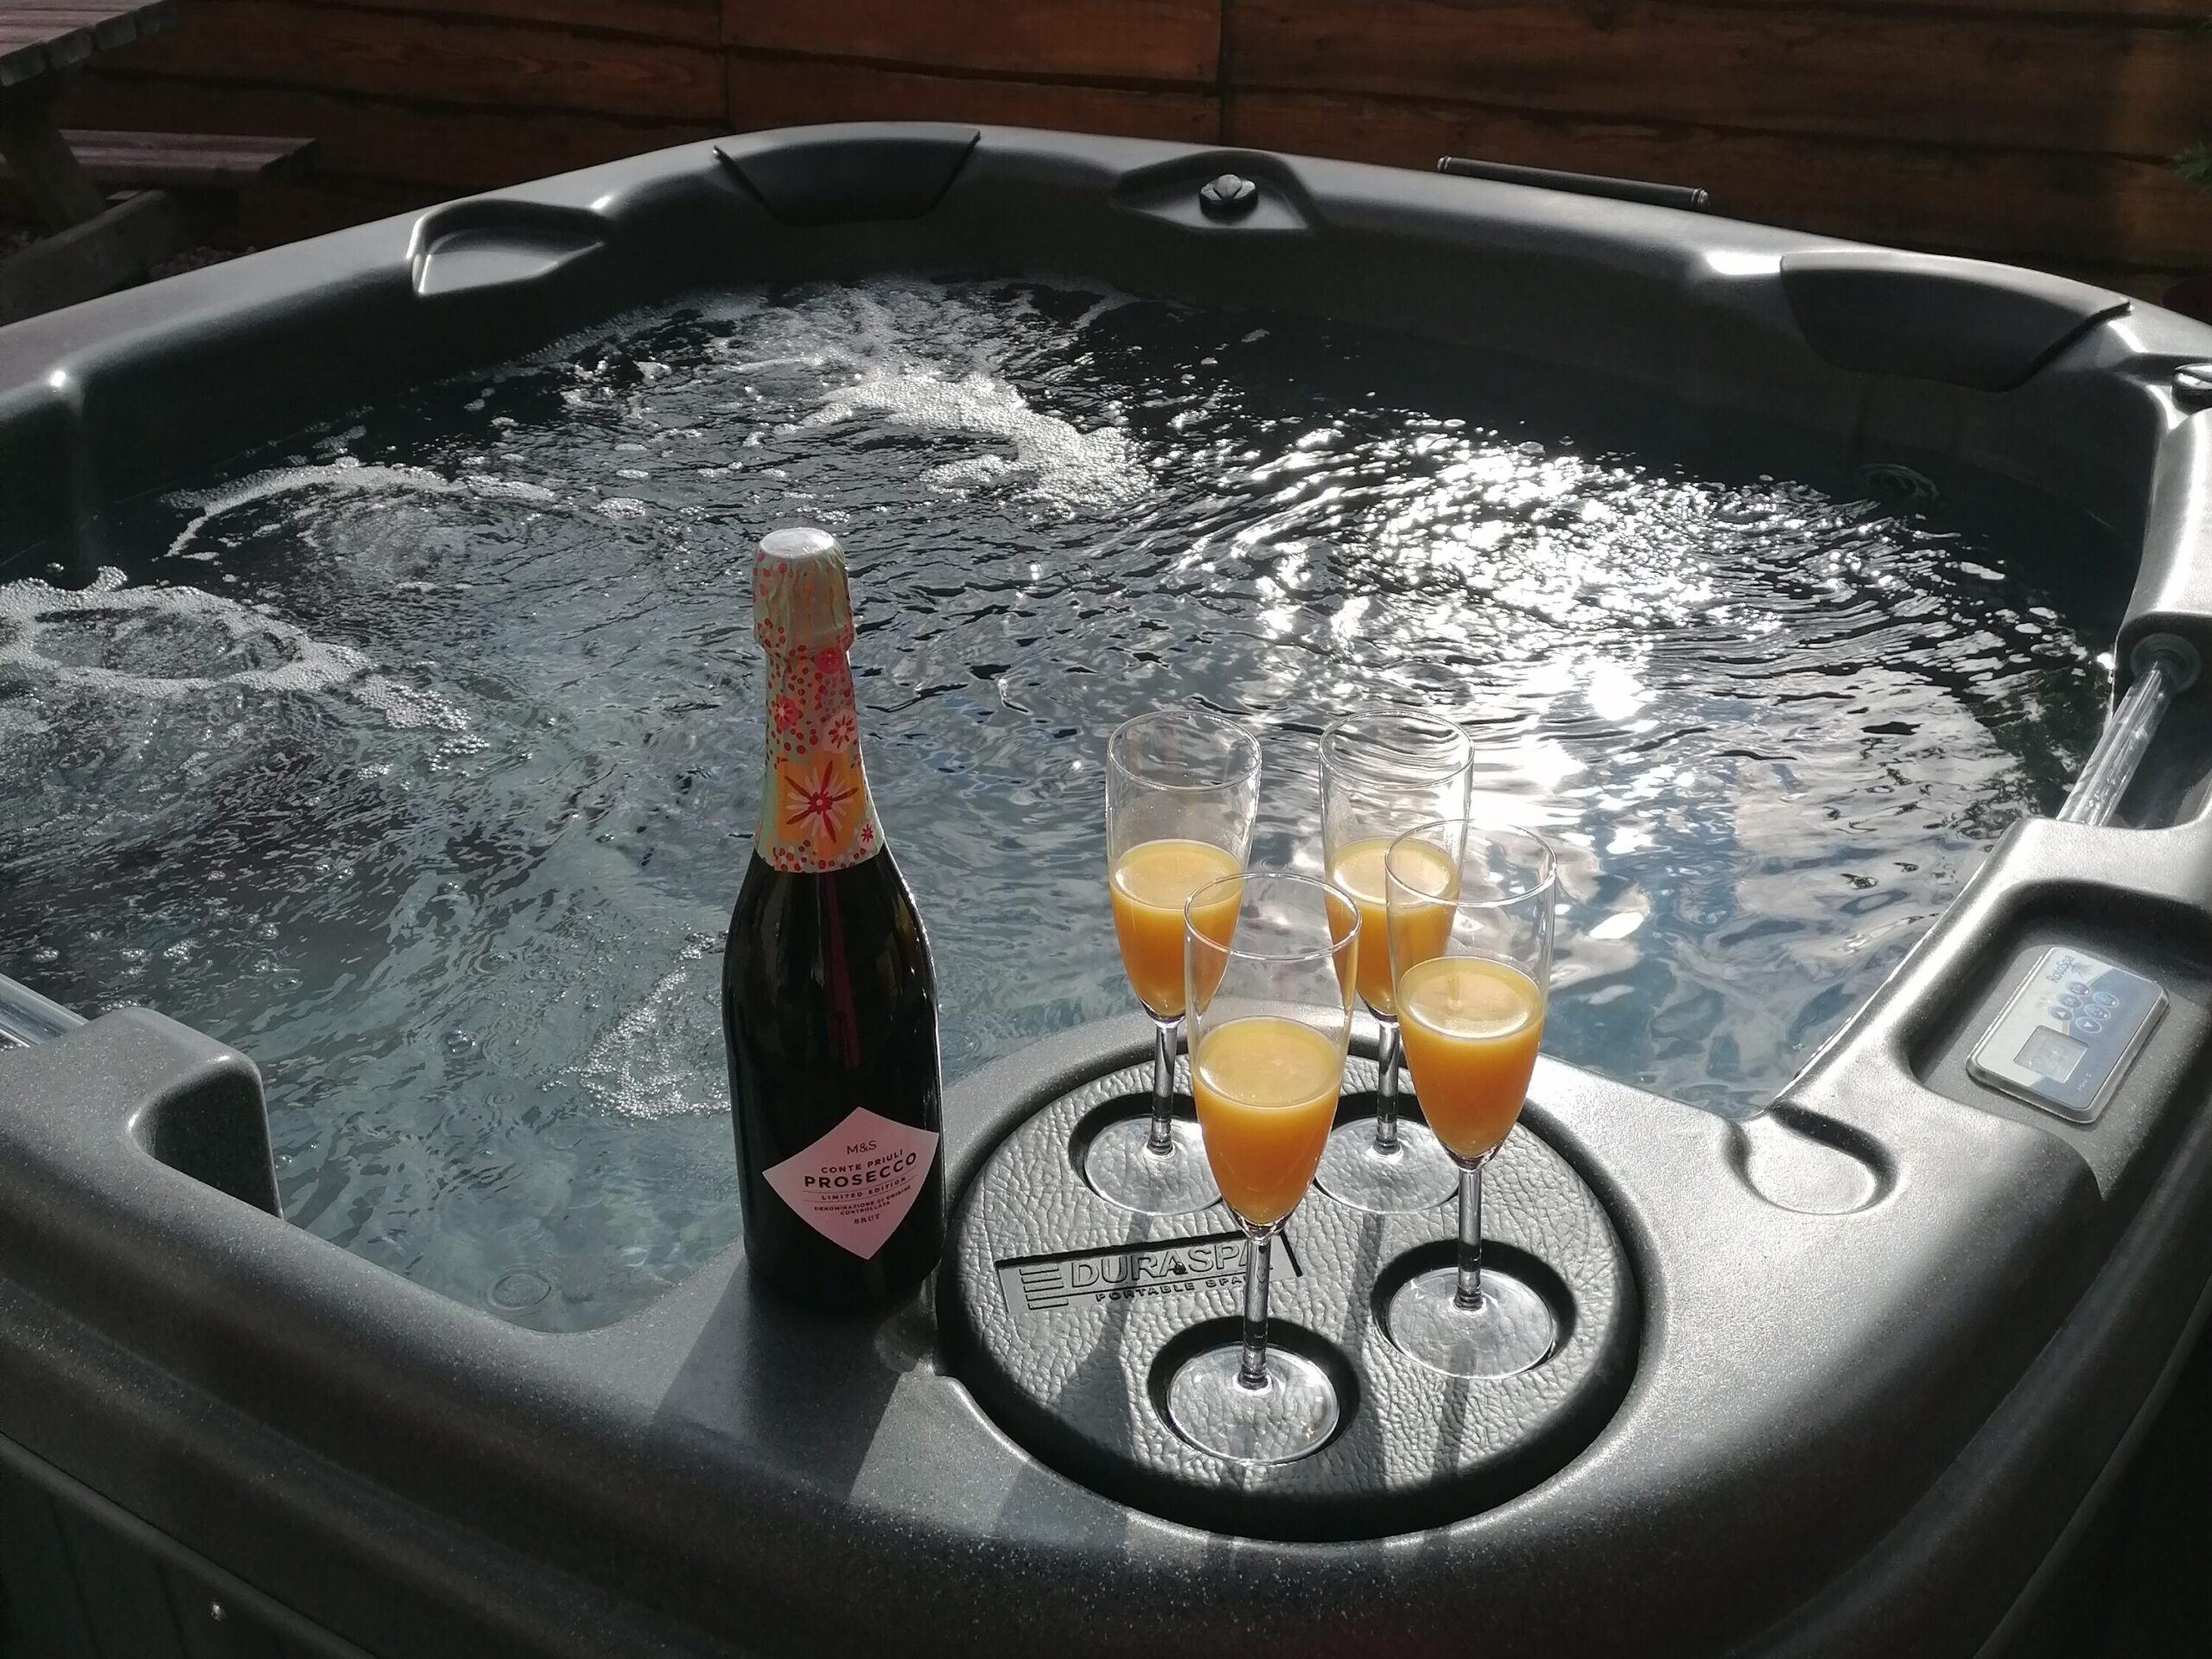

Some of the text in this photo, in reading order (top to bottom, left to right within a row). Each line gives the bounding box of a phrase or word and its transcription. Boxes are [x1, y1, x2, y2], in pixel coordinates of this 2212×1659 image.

[847, 1141, 877, 1154] M&S
[804, 1152, 916, 1188] PROSECCO
[821, 1148, 903, 1173] CONTE PRIULI
[821, 1177, 906, 1200] LIMITED EDITION
[840, 1201, 890, 1215] CONTROLLATA
[854, 1213, 880, 1224] BRUT
[1096, 1274, 1247, 1302] PORTABLE SPA
